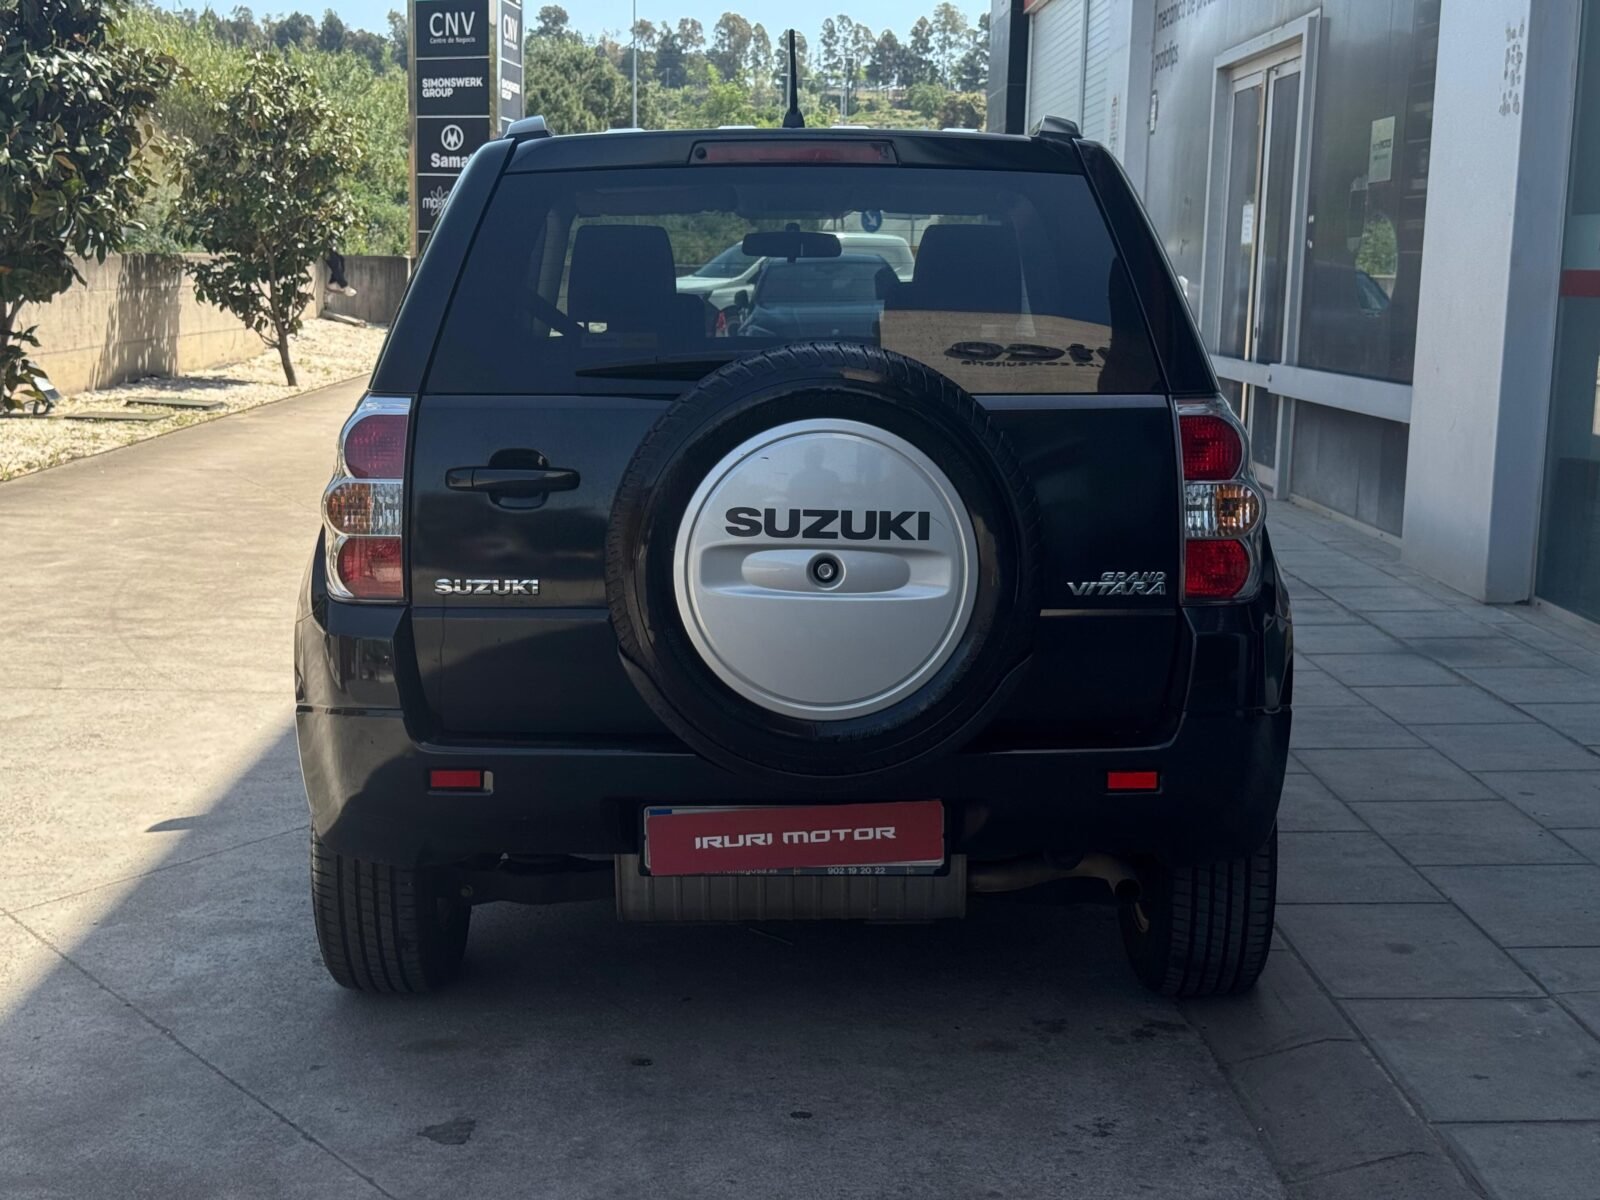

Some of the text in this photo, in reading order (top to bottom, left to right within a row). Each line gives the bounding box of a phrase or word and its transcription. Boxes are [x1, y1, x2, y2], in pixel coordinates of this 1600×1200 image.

[429, 11, 476, 37] CNV
[422, 77, 483, 88] SIMONSWERK
[422, 88, 454, 97] GROUP
[725, 506, 930, 541] SUZUKI
[1100, 571, 1167, 582] GRAND
[434, 578, 539, 595] SUZUKI
[1066, 582, 1167, 595] VITARA
[695, 826, 896, 849] IRURI MOTOR
[827, 867, 886, 875] 902 19 20 22
